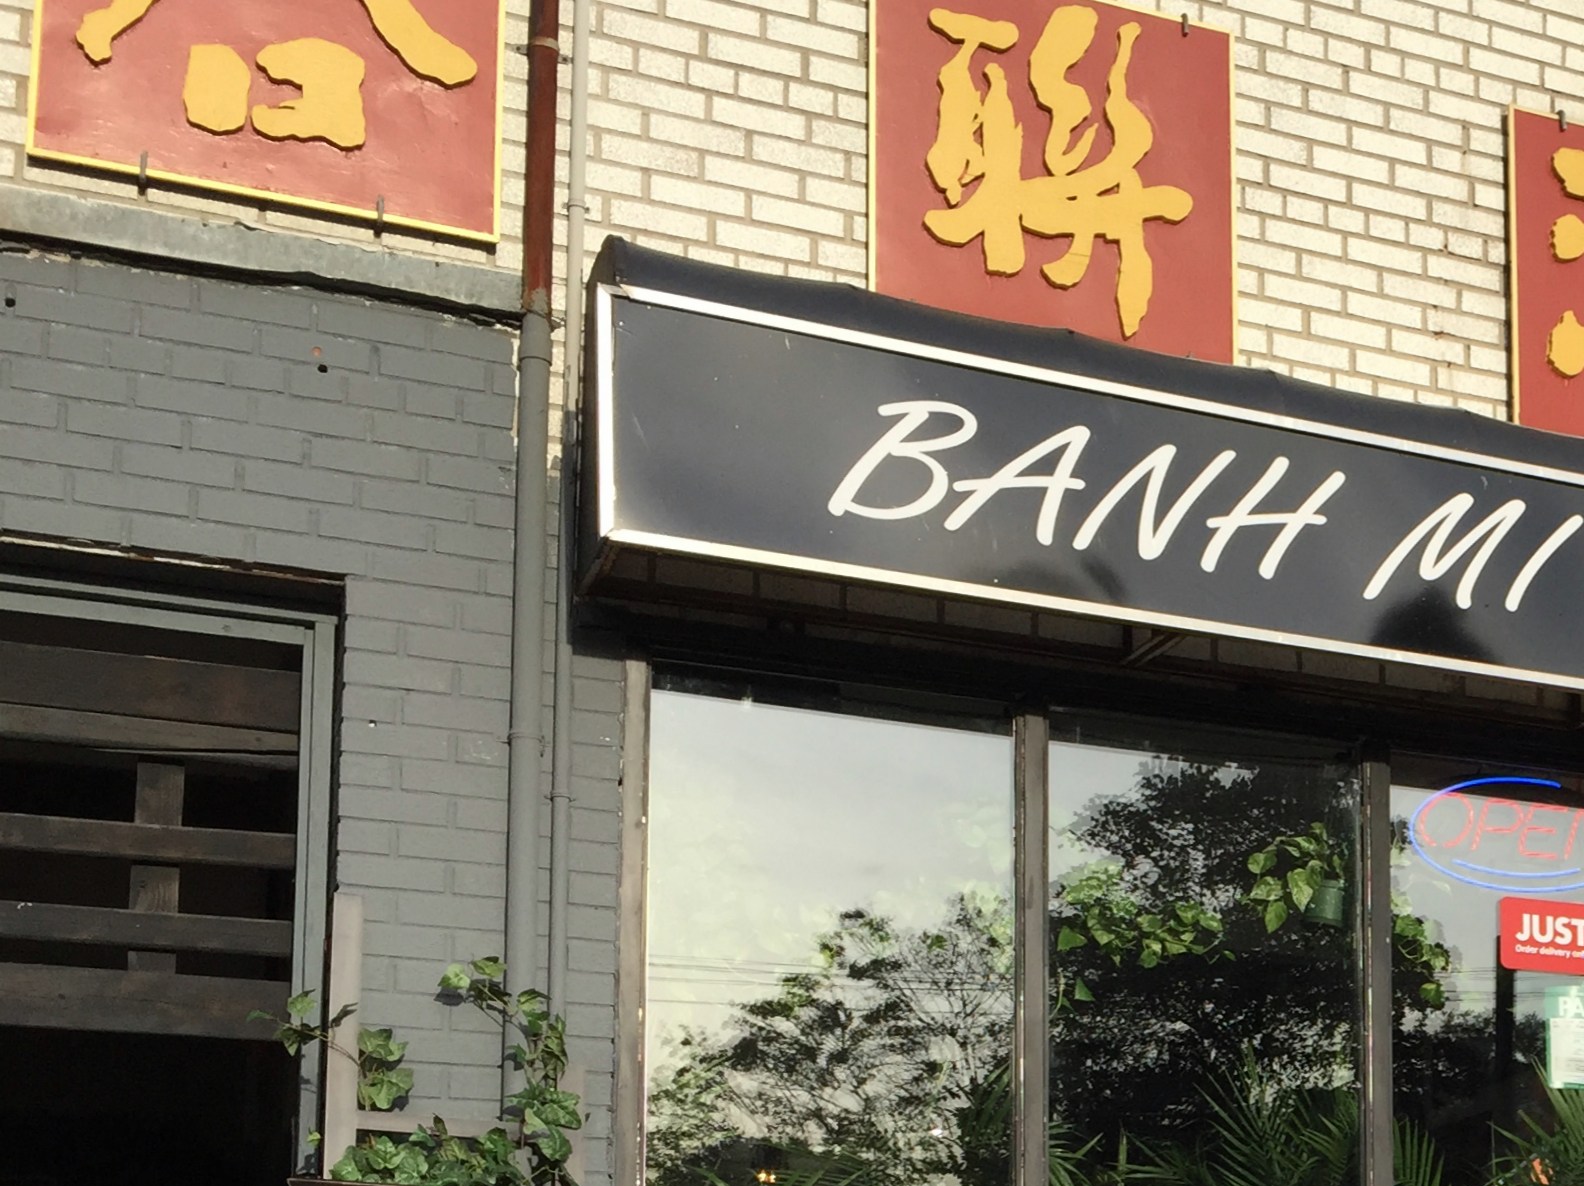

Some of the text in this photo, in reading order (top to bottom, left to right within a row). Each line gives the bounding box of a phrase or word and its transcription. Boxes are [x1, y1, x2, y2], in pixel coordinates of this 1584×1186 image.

[828, 401, 1345, 581] BANH
[1365, 494, 1583, 613] MI
[1515, 944, 1539, 954] Order
[1539, 946, 1571, 959] delivery
